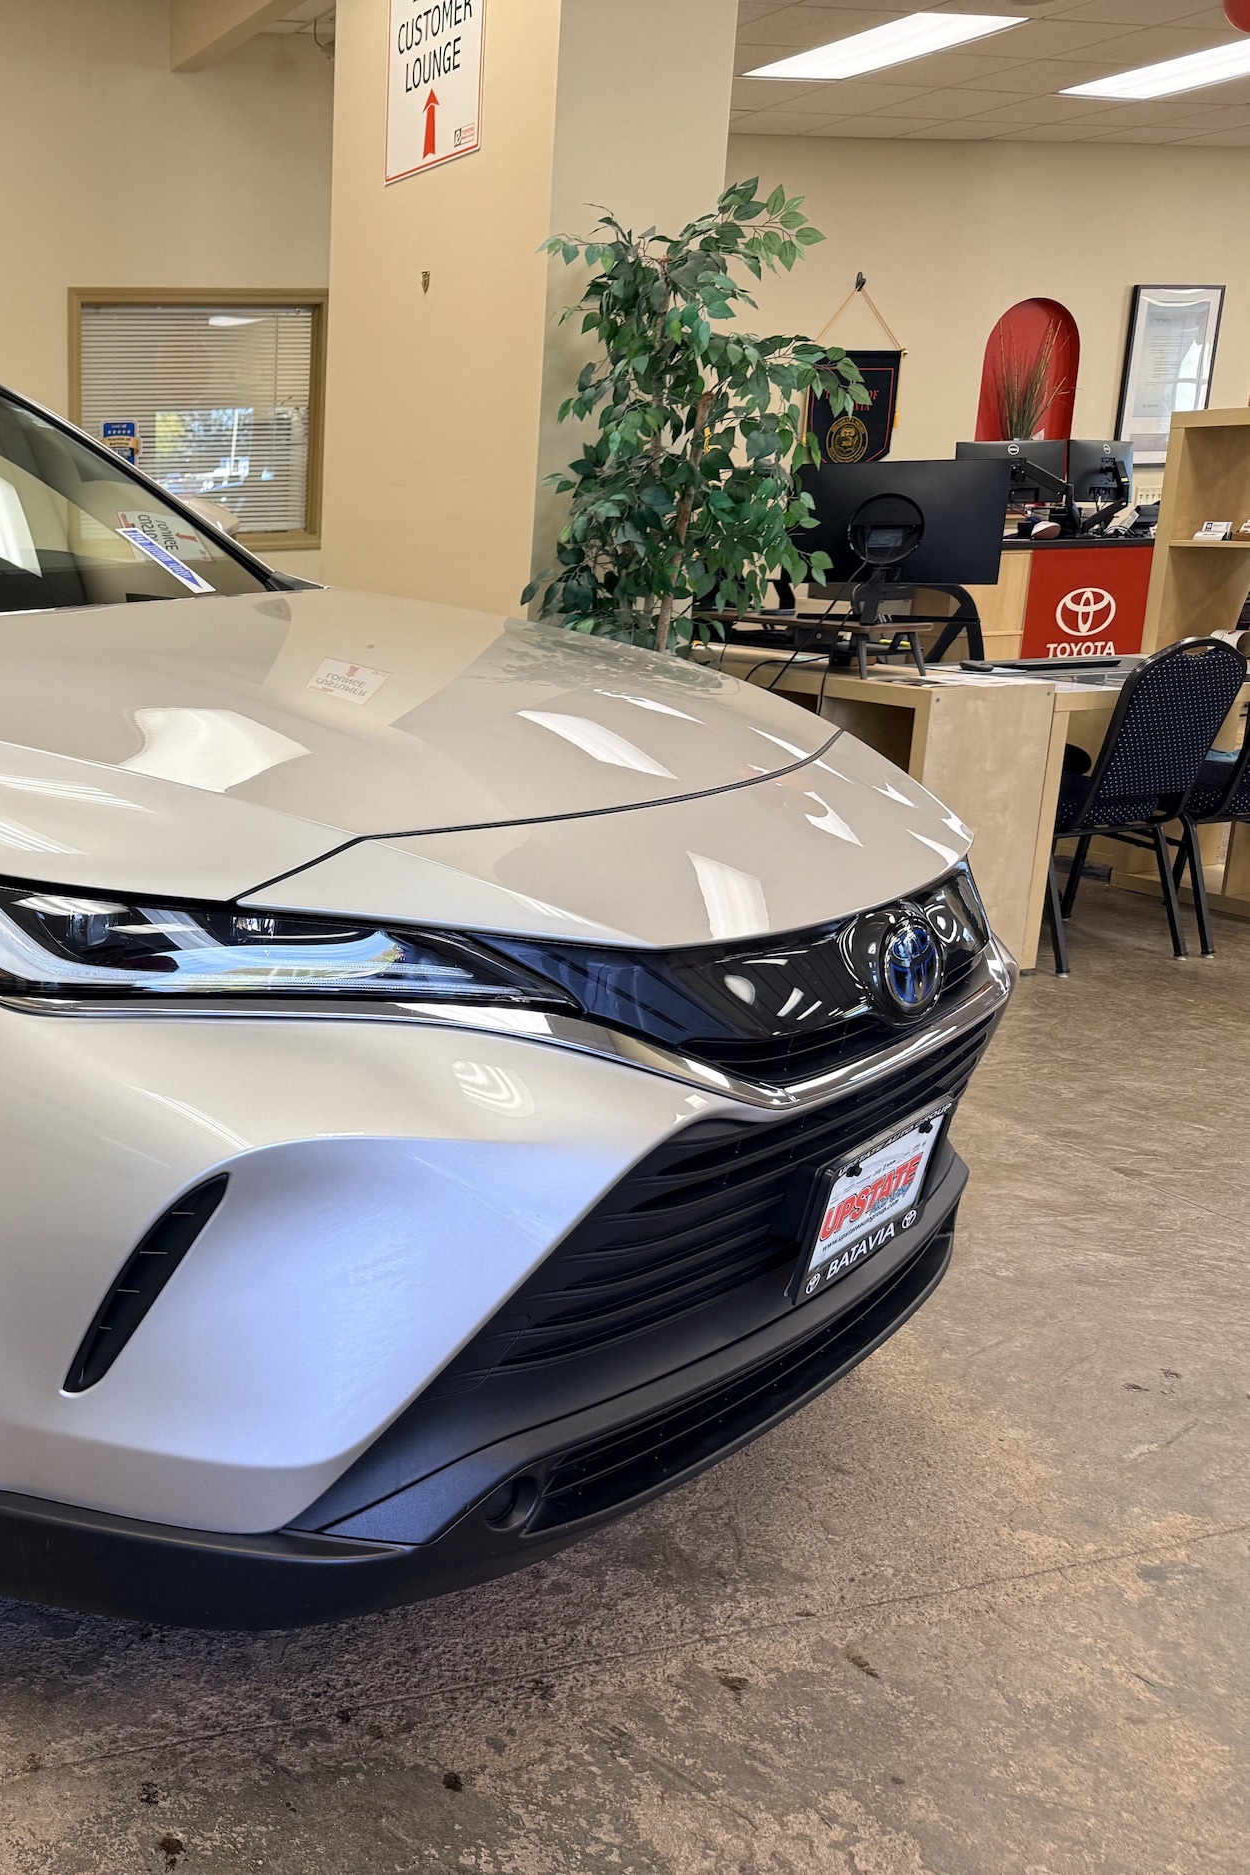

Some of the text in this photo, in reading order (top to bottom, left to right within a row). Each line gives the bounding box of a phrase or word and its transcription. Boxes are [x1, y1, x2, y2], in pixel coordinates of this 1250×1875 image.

[398, 0, 472, 55] CUSTOMER
[406, 37, 461, 93] LOUNGE
[1046, 641, 1116, 658] TOYOTA
[884, 1124, 913, 1147] AUTO
[819, 1154, 923, 1241] UPSTATE
[826, 1222, 895, 1281] BATAVIA
